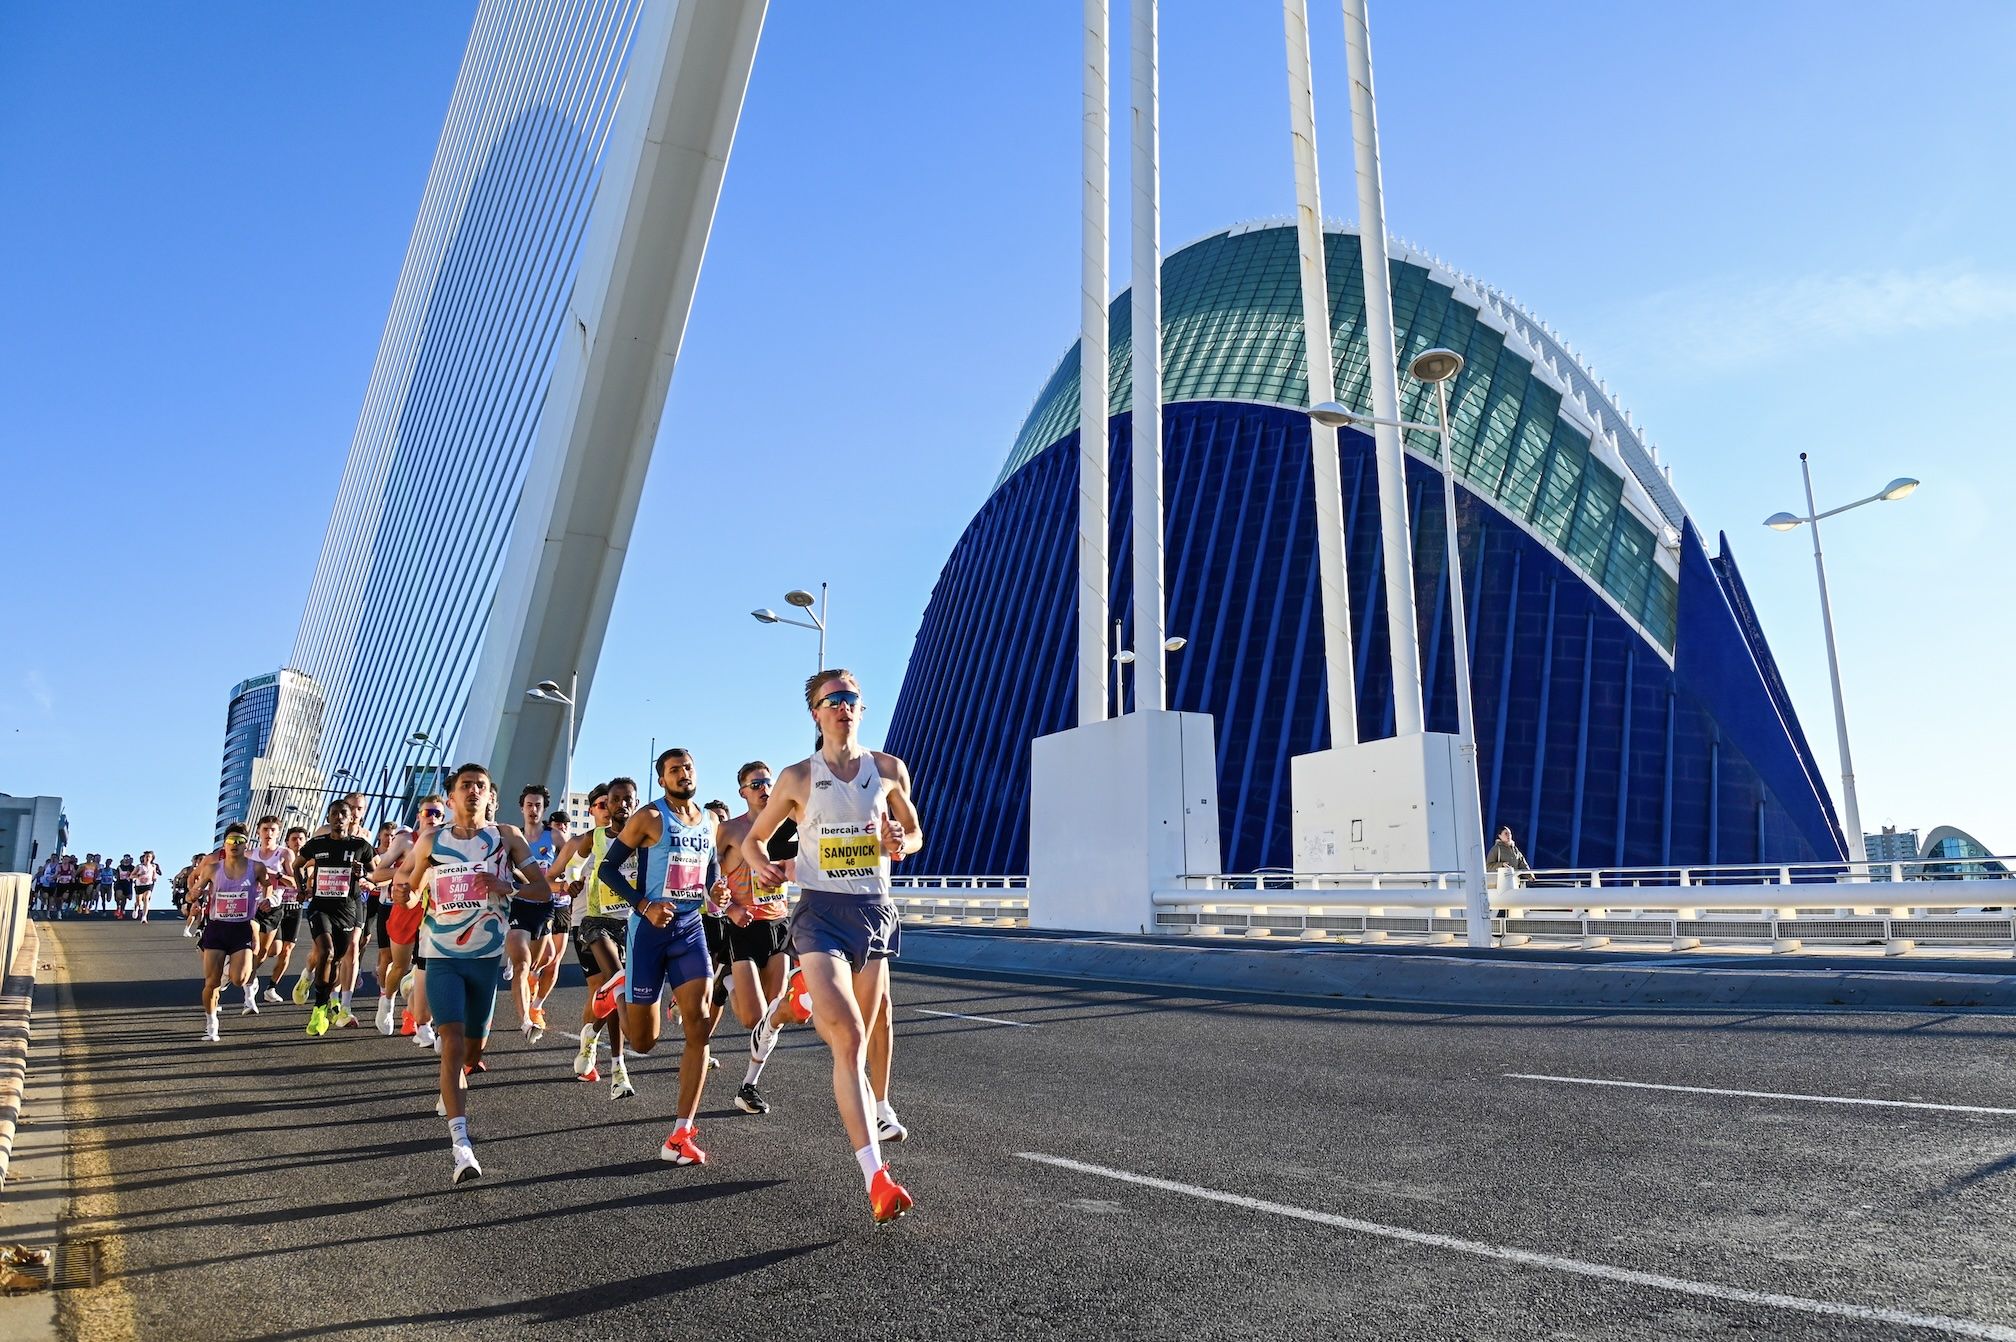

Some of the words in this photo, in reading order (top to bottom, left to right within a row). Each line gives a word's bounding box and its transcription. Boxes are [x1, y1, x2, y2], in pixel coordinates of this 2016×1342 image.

[821, 825, 859, 834] Ibercaja
[670, 833, 709, 852] nerja
[343, 850, 355, 863] H
[824, 845, 875, 858] SANDVICK
[672, 855, 698, 864] Ibercaja
[845, 858, 856, 866] 46
[826, 867, 875, 878] KIPRUN
[449, 883, 469, 893] SAID
[605, 902, 633, 911] KIPRU
